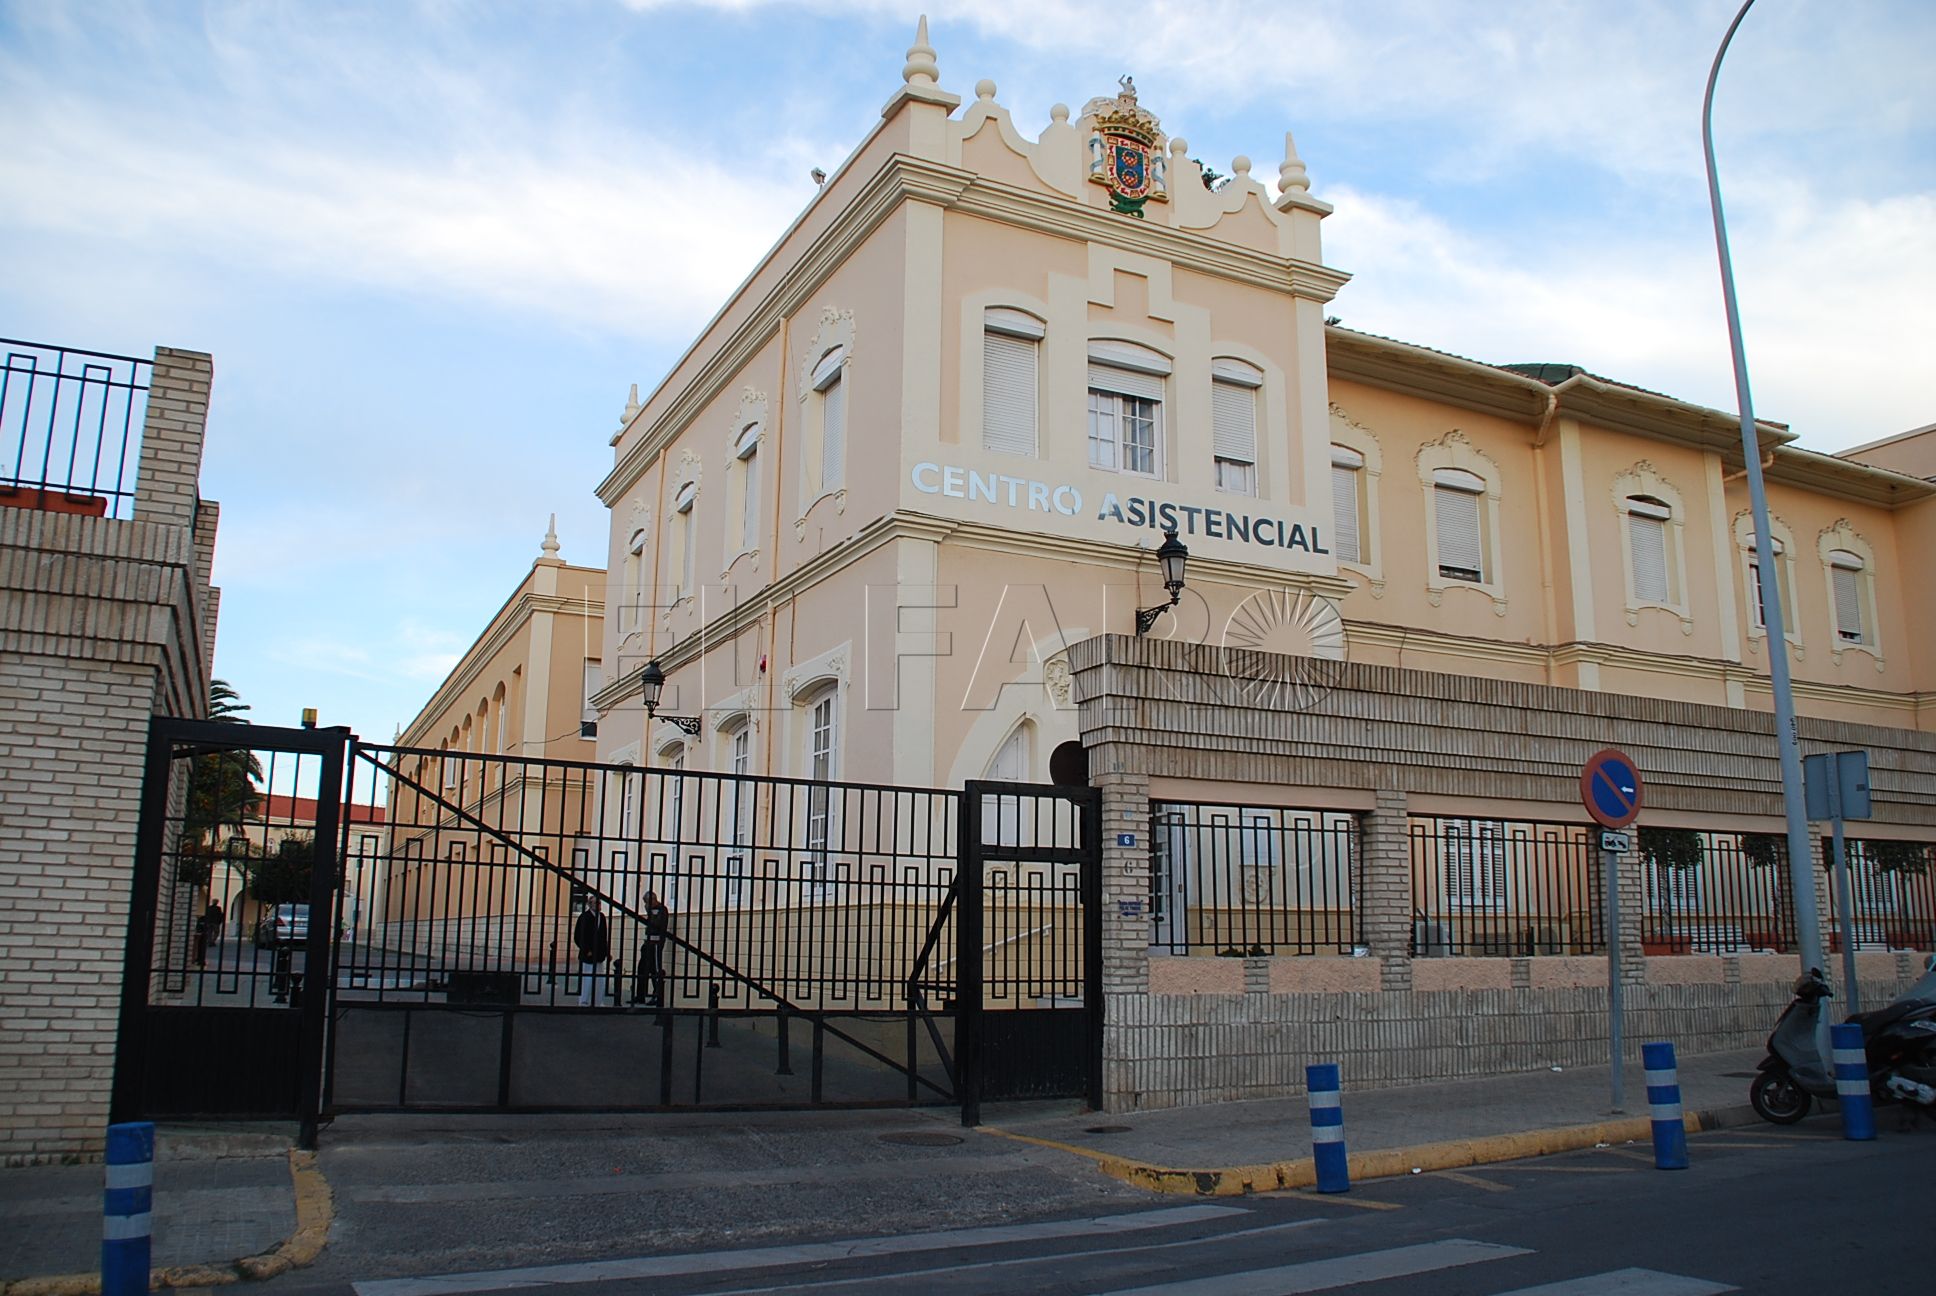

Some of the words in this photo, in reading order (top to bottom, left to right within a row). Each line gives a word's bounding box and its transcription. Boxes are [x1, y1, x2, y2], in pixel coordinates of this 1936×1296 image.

[911, 461, 1083, 516] CENTRO
[1097, 492, 1329, 555] ASISTENCIAL
[1124, 835, 1130, 845] 6
